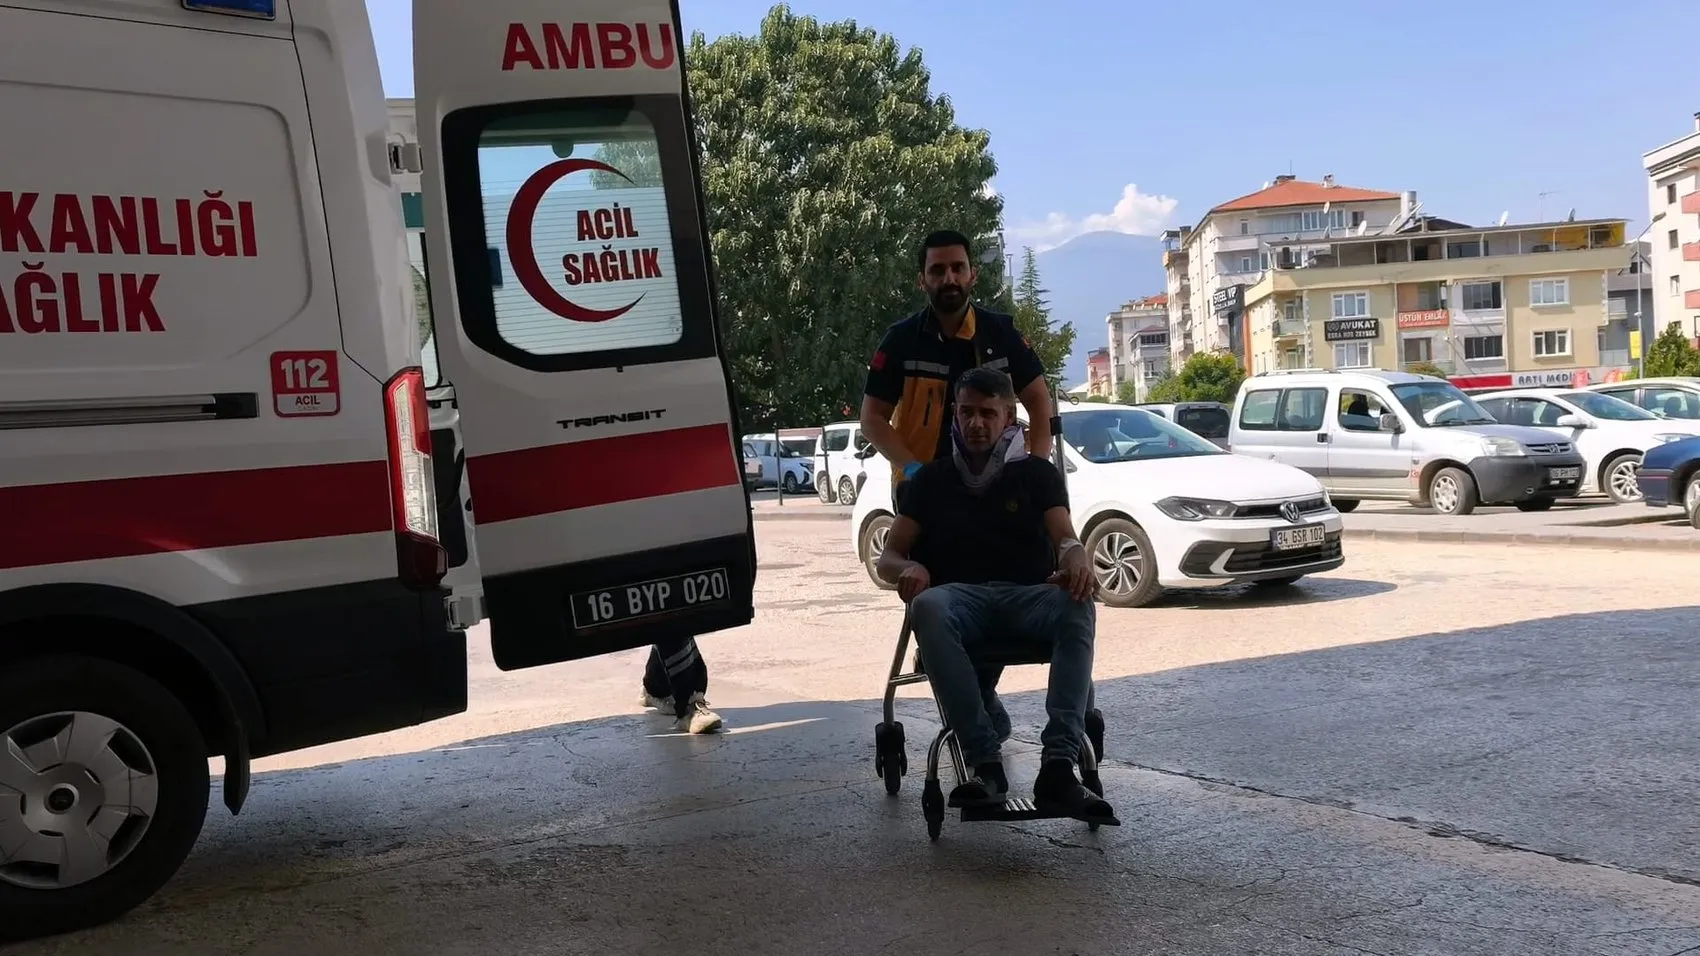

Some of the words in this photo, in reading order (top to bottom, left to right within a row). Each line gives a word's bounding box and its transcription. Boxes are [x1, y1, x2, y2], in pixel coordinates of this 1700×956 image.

[502, 23, 675, 71] AMBU
[0, 189, 257, 257] KANLIĞI
[577, 202, 639, 241] ACİL
[562, 244, 663, 285] SAĞLIK
[1340, 320, 1376, 330] AVUKAT
[280, 358, 330, 389] 112
[1518, 375, 1542, 385] ARTI
[1546, 372, 1592, 384] MEDİL
[556, 408, 666, 429] TRANSIT
[1277, 532, 1288, 545] 34
[1292, 530, 1307, 543] GSR
[1309, 527, 1323, 541] 102
[587, 592, 615, 622] 16
[626, 581, 671, 615] BYP
[683, 572, 726, 604] 020
